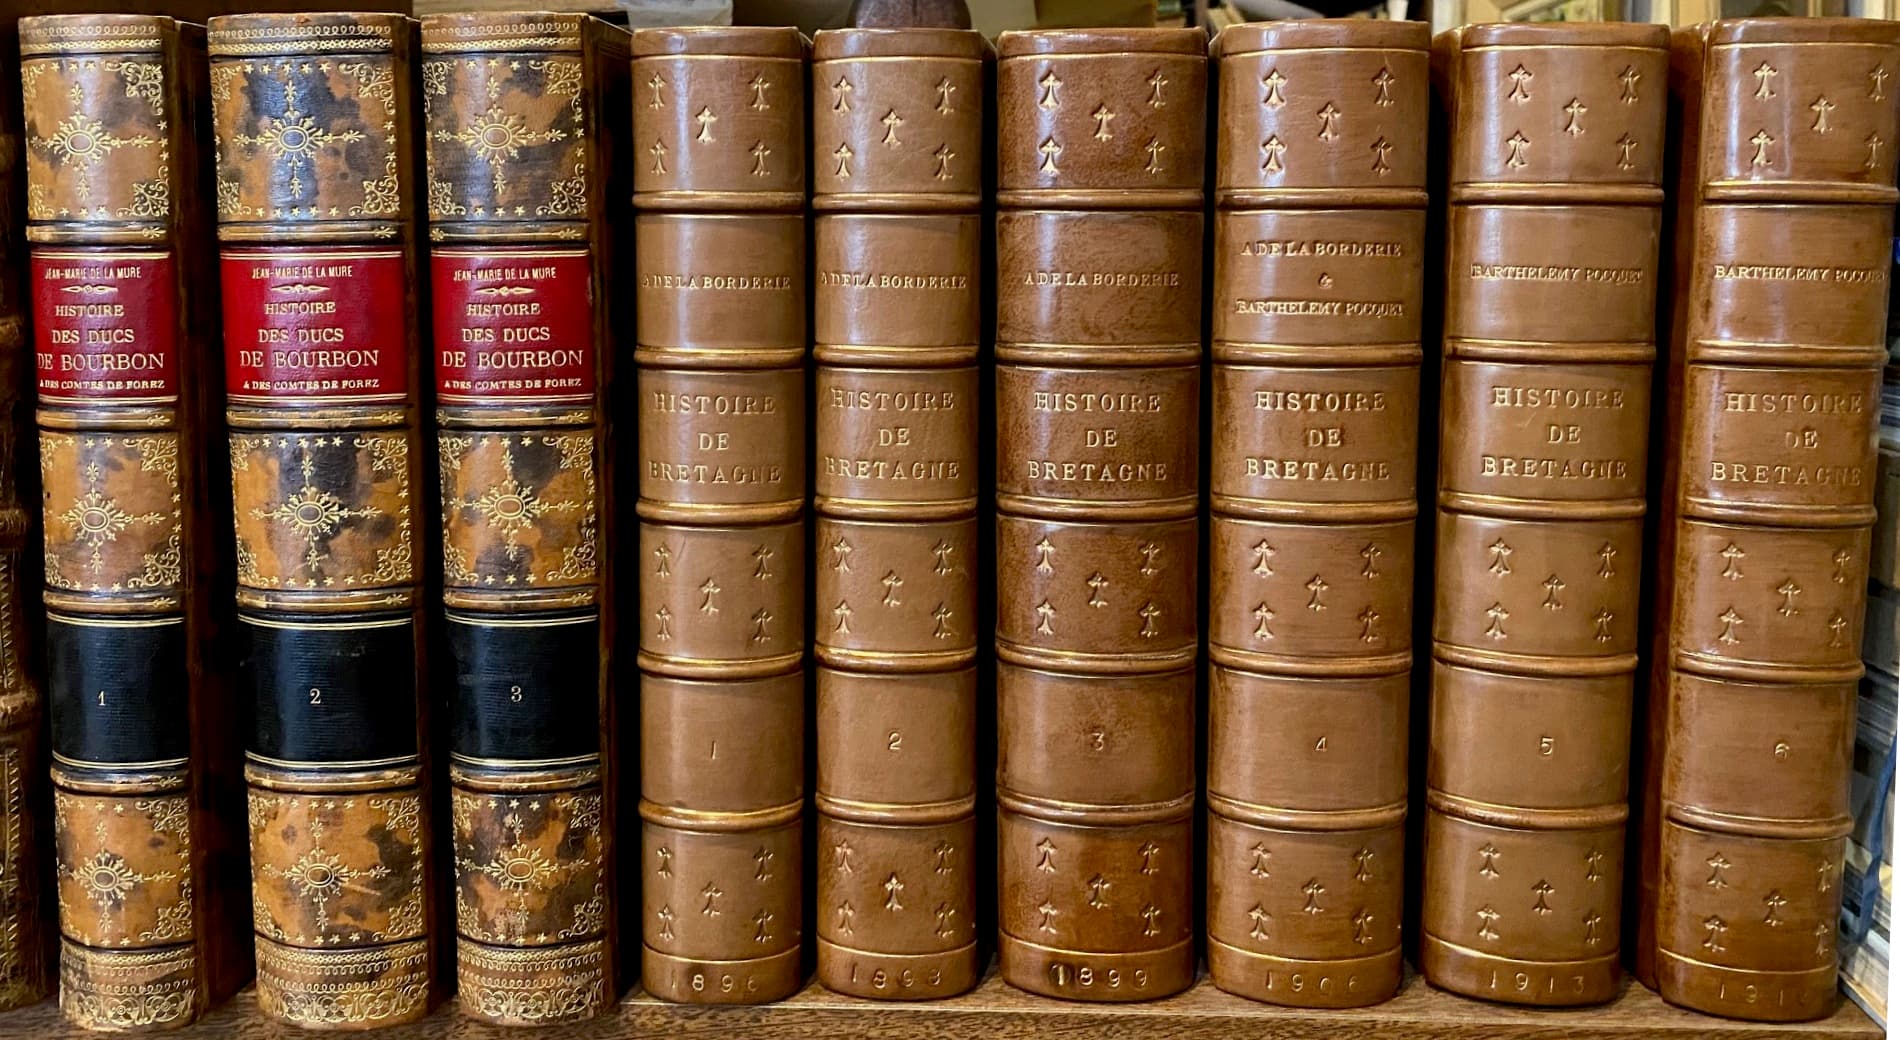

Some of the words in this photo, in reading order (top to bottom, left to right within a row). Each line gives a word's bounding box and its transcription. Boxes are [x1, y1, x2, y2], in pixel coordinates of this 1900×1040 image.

[1315, 241, 1401, 257] BORDERIE
[45, 266, 86, 280] JEAN-MARIE
[90, 266, 100, 280] DE
[104, 266, 114, 279] LA
[117, 266, 142, 279] MURE
[252, 266, 299, 280] JEAN-MARIE
[302, 266, 313, 279] DE
[316, 265, 326, 278] LA
[329, 265, 353, 278] MURE
[453, 268, 502, 282] JEAN-MARIE
[505, 267, 515, 280] DE
[519, 267, 530, 280] LA
[532, 266, 556, 279] MURE
[880, 274, 967, 289] BORDERIE
[1093, 272, 1179, 287] BORDERIE
[1319, 273, 1333, 289] &
[1471, 264, 1581, 281] BARTHELEMY
[1714, 265, 1830, 281] BARTHELEMY
[702, 274, 791, 290] BORDERIE
[55, 304, 125, 317] HISTOIRE
[264, 302, 336, 315] HISTOIRE
[466, 302, 541, 317] HISTOIRE
[1235, 300, 1342, 316] BARTHELEMY
[52, 329, 80, 344] DES
[87, 328, 135, 344] DUCS
[258, 329, 289, 343] DES
[297, 328, 344, 343] DUCS
[462, 327, 494, 343] DES
[503, 327, 550, 342] DUCS
[37, 352, 54, 370] DE
[61, 352, 165, 371] BOURBON
[239, 350, 264, 368] DE
[274, 349, 379, 368] BOURBON
[442, 350, 466, 368] DE
[477, 349, 584, 369] BOURBON
[44, 380, 59, 389] DES
[61, 380, 104, 390] COMTES
[106, 380, 123, 390] DE
[125, 380, 165, 389] FOREZ
[252, 380, 271, 390] DES
[274, 380, 319, 390] COMTES
[322, 380, 338, 389] DE
[342, 379, 379, 389] FOREZ
[452, 380, 471, 390] DES
[474, 380, 522, 390] COMTES
[525, 379, 542, 389] DE
[544, 378, 582, 389] FOREZ
[654, 392, 777, 415] HISTOIRE
[831, 386, 954, 412] HISTOIRE
[1034, 391, 1161, 414] HISTOIRE
[1254, 391, 1385, 413] HISTOIRE
[1492, 386, 1624, 409] HISTOIRE
[1725, 392, 1861, 413] HISTOIRE
[698, 433, 730, 451] DE
[879, 427, 910, 447] DE
[1085, 430, 1118, 448] DE
[1307, 428, 1341, 447] DE
[1547, 424, 1580, 443] DE
[1785, 430, 1817, 449] DE
[648, 461, 782, 484] BRETAGNE
[825, 457, 959, 480] BRETAGNE
[1027, 459, 1168, 482] BRETAGNE
[1246, 458, 1390, 482] BRETAGNE
[1482, 456, 1627, 479] BRETAGNE
[1711, 461, 1862, 486] BRETAGNE
[97, 691, 106, 706] 1
[310, 689, 321, 705] 2
[510, 686, 522, 702] 3
[710, 740, 717, 759] 1
[888, 730, 901, 751] 2
[1090, 732, 1104, 751] 3
[1315, 736, 1327, 753] 4
[1539, 737, 1554, 756] 5
[1775, 741, 1789, 760] 6
[1052, 964, 1147, 987] 1899
[1490, 971, 1584, 994] 1913
